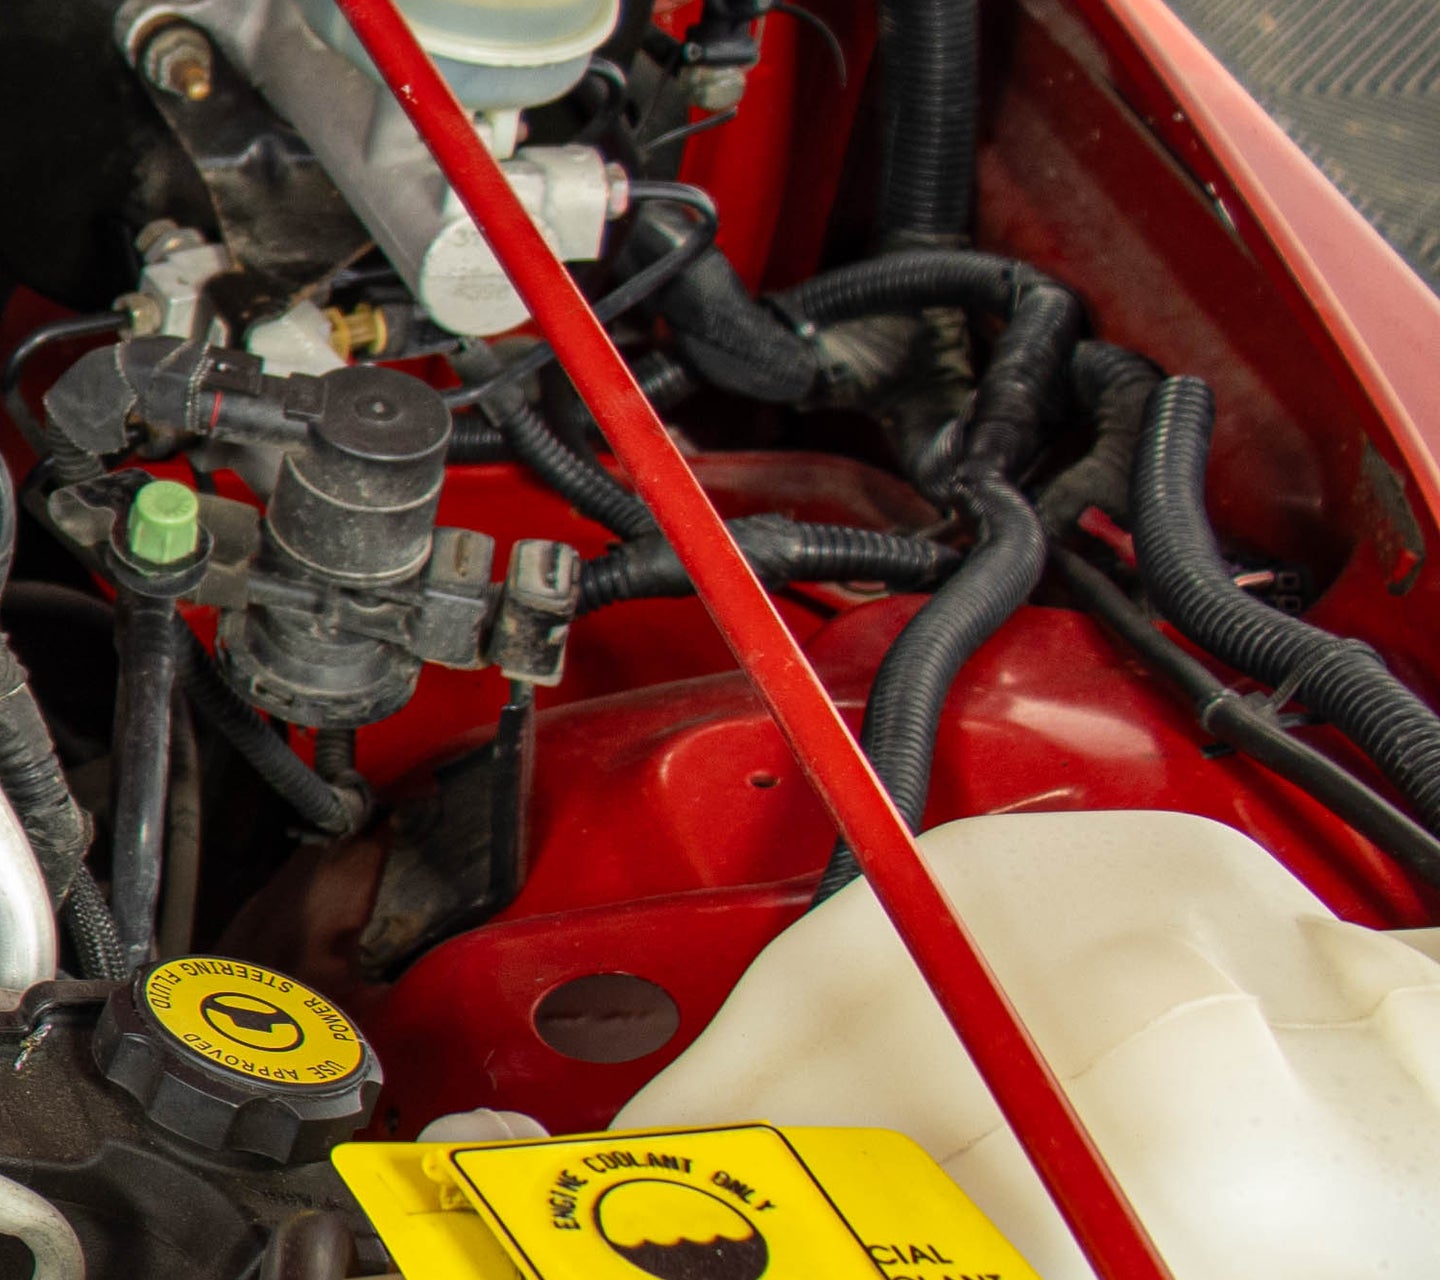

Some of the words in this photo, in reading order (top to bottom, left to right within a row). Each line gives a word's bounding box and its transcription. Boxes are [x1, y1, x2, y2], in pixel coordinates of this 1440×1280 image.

[150, 969, 183, 1010] FLUID
[180, 960, 295, 994] STEERING
[303, 996, 355, 1043] POWER
[182, 1032, 300, 1081] APPROVED
[306, 1059, 347, 1080] USE
[547, 1169, 589, 1231] ENGINE
[582, 1150, 694, 1174] COOLANT
[710, 1170, 777, 1212] ONLY
